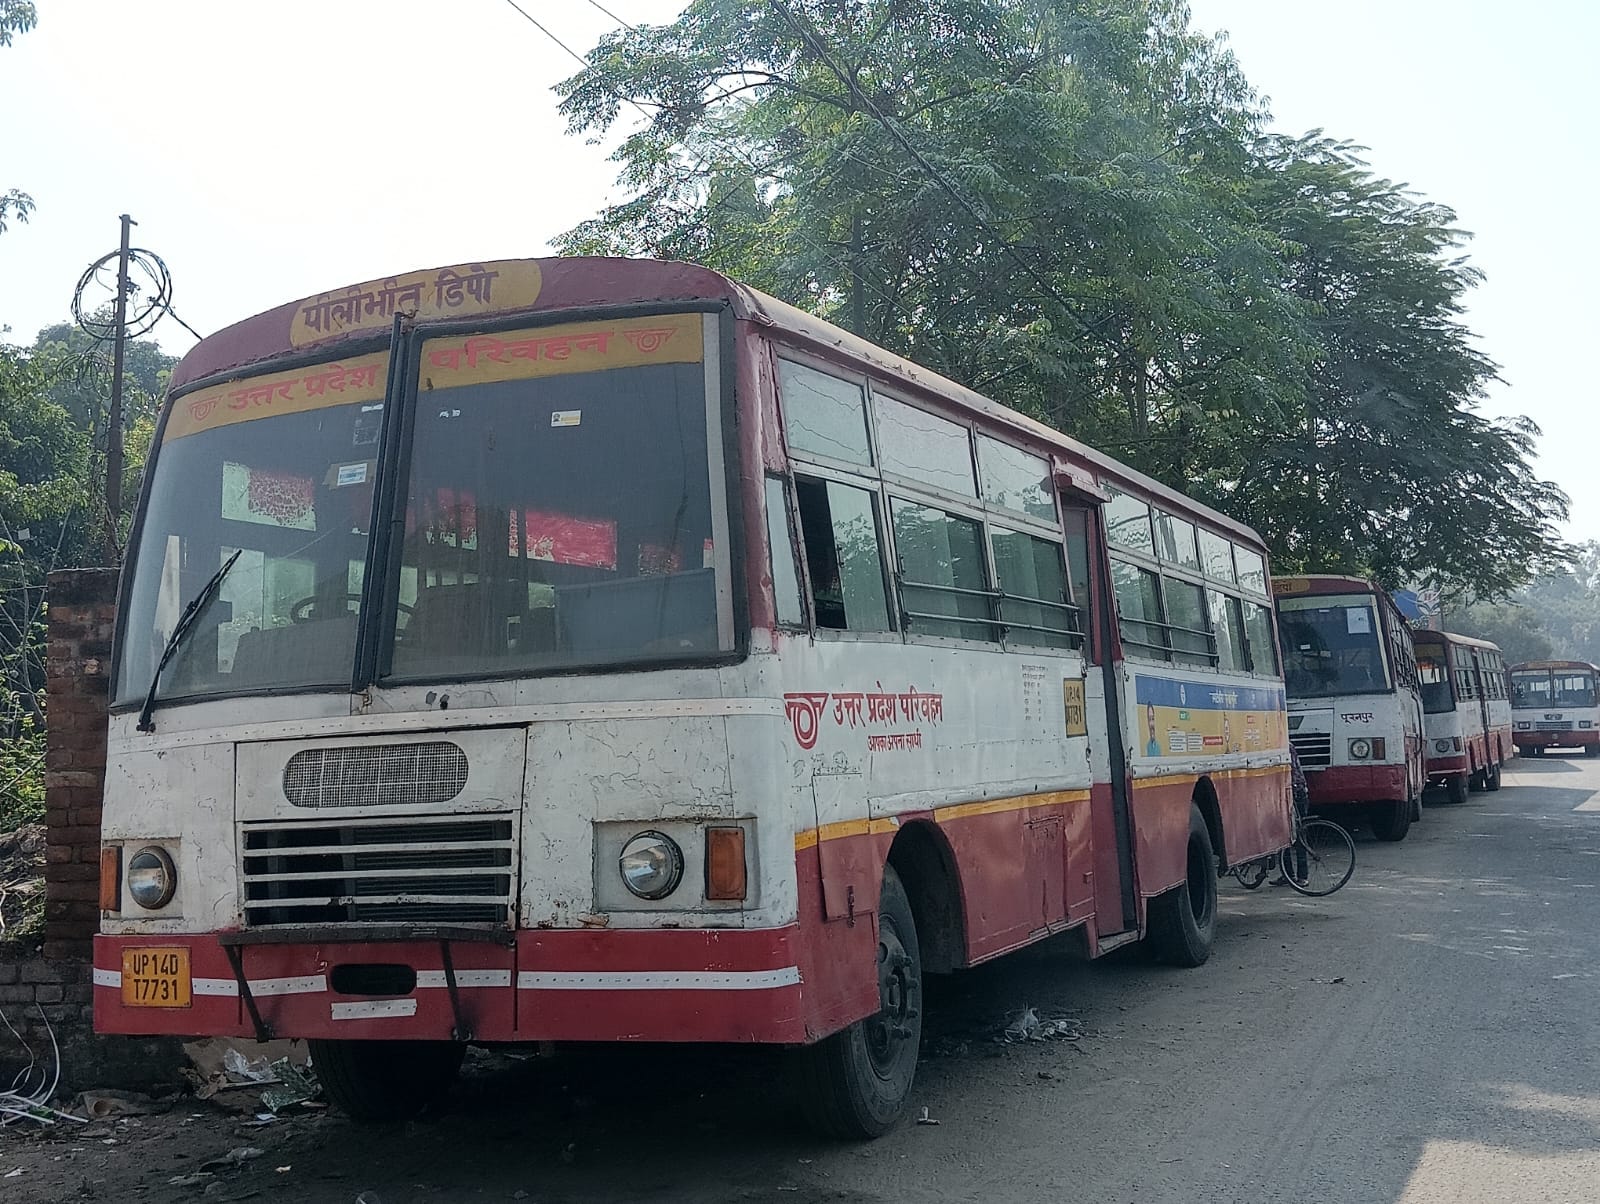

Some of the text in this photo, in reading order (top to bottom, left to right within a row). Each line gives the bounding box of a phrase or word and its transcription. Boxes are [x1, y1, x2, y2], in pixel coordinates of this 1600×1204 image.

[303, 265, 499, 333] पीलीभीत डिपो
[228, 330, 615, 410] उत्तर प्रदेश परिवहन
[832, 681, 943, 730] उत्तर प्रदेश परिवहन
[1340, 712, 1375, 724] पूरनपुर
[133, 978, 178, 1000] T7731
